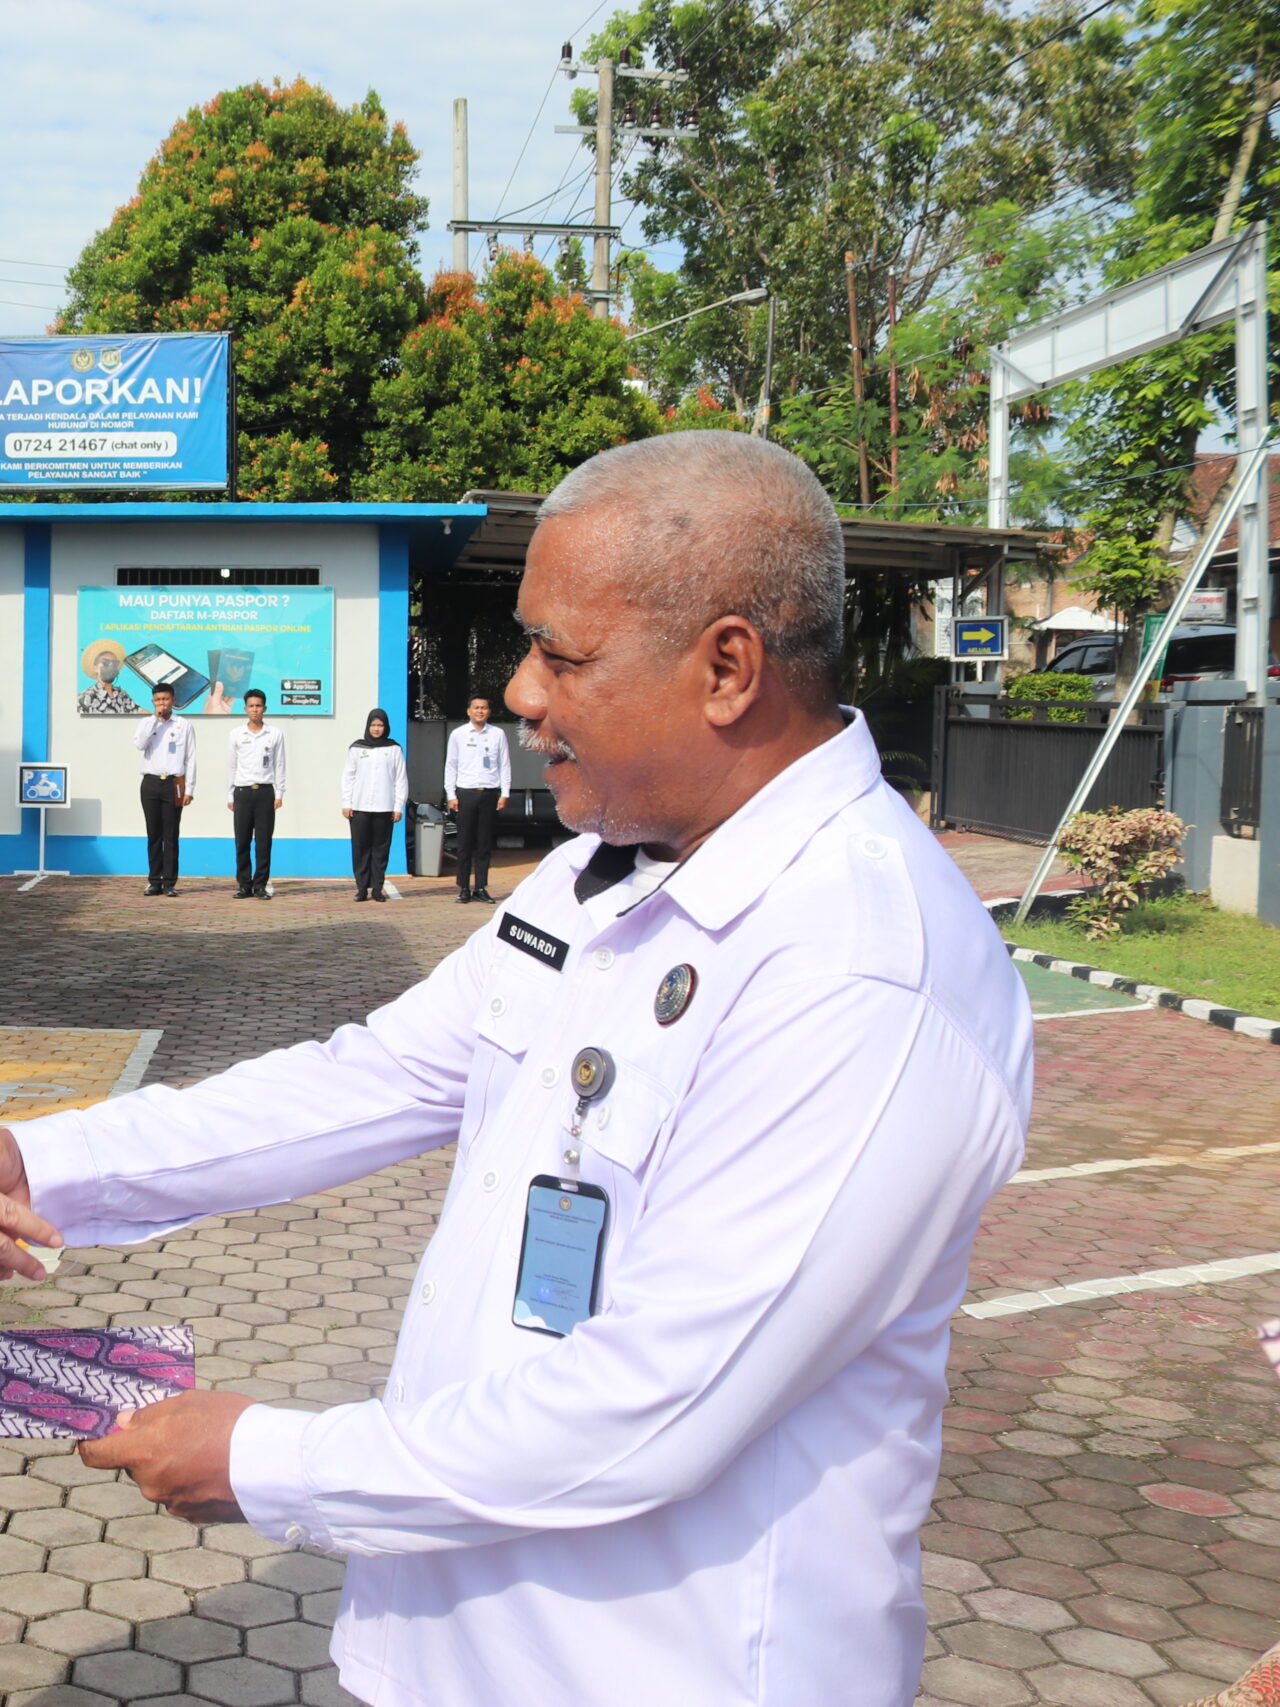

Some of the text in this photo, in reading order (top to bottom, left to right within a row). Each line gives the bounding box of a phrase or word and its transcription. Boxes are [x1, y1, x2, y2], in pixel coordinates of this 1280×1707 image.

[7, 412, 43, 421] TERJADI
[45, 412, 87, 420] KENDALA
[89, 412, 119, 420] DALAM
[122, 411, 174, 420] PELAYANAN
[176, 411, 199, 419] KAMI
[47, 421, 135, 430] HUBUNGI DI NOMOR
[13, 438, 53, 452] 0724
[59, 438, 108, 452] 21467
[111, 440, 139, 452] (chat
[140, 440, 163, 452] only
[0, 462, 23, 470] KAMI
[24, 462, 89, 470] BERKOMITMEN
[90, 461, 121, 470] UNTUK
[123, 461, 183, 470] MEMBERIKAN
[28, 471, 81, 479] PELAYANAN
[82, 471, 118, 479] SANGAT
[119, 470, 141, 479] BAIK
[119, 595, 155, 607] MAU
[158, 595, 212, 607] PUNYA
[215, 595, 279, 608] PASPOR
[150, 610, 259, 620] DAFTAR M-PASPOR
[23, 771, 34, 784] P
[509, 924, 557, 958] SUWARDI
